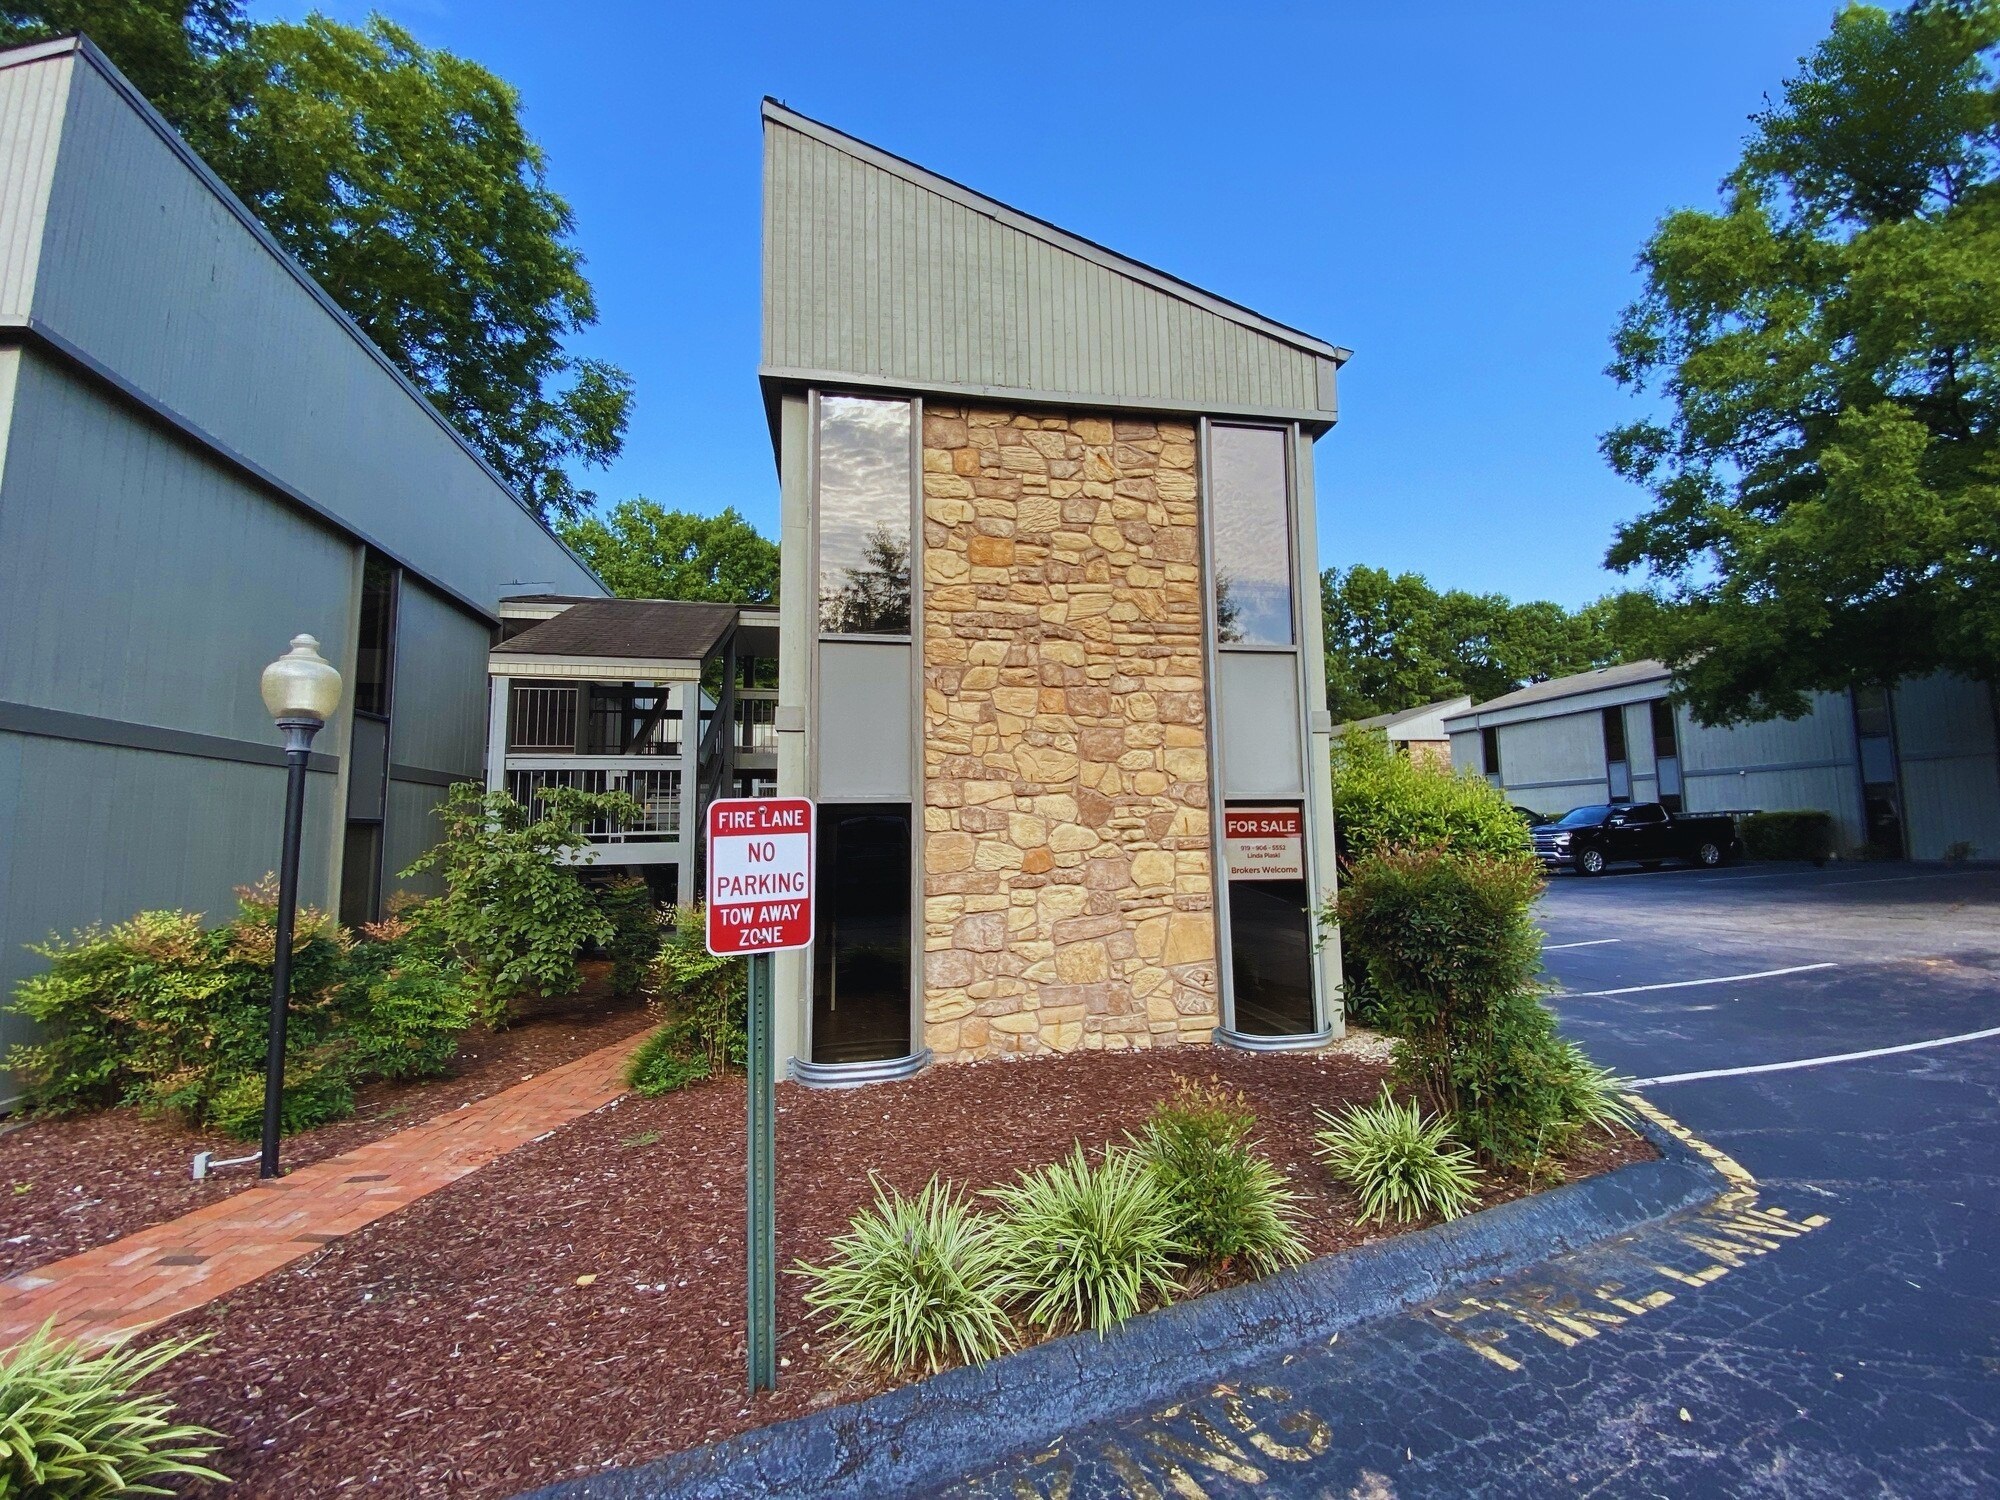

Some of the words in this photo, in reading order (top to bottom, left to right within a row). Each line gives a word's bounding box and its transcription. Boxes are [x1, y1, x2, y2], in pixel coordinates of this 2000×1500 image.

[718, 811, 756, 829] FIRE
[761, 809, 804, 828] LANE
[1228, 820, 1258, 833] FOR
[1260, 820, 1296, 832] SALE
[748, 841, 776, 863] NO
[1231, 866, 1261, 874] Brokers
[1262, 866, 1298, 874] Welcome
[717, 871, 805, 898] PARKING
[720, 906, 754, 926] TOW
[759, 903, 802, 923] AWAY
[739, 926, 784, 947] ZONE
